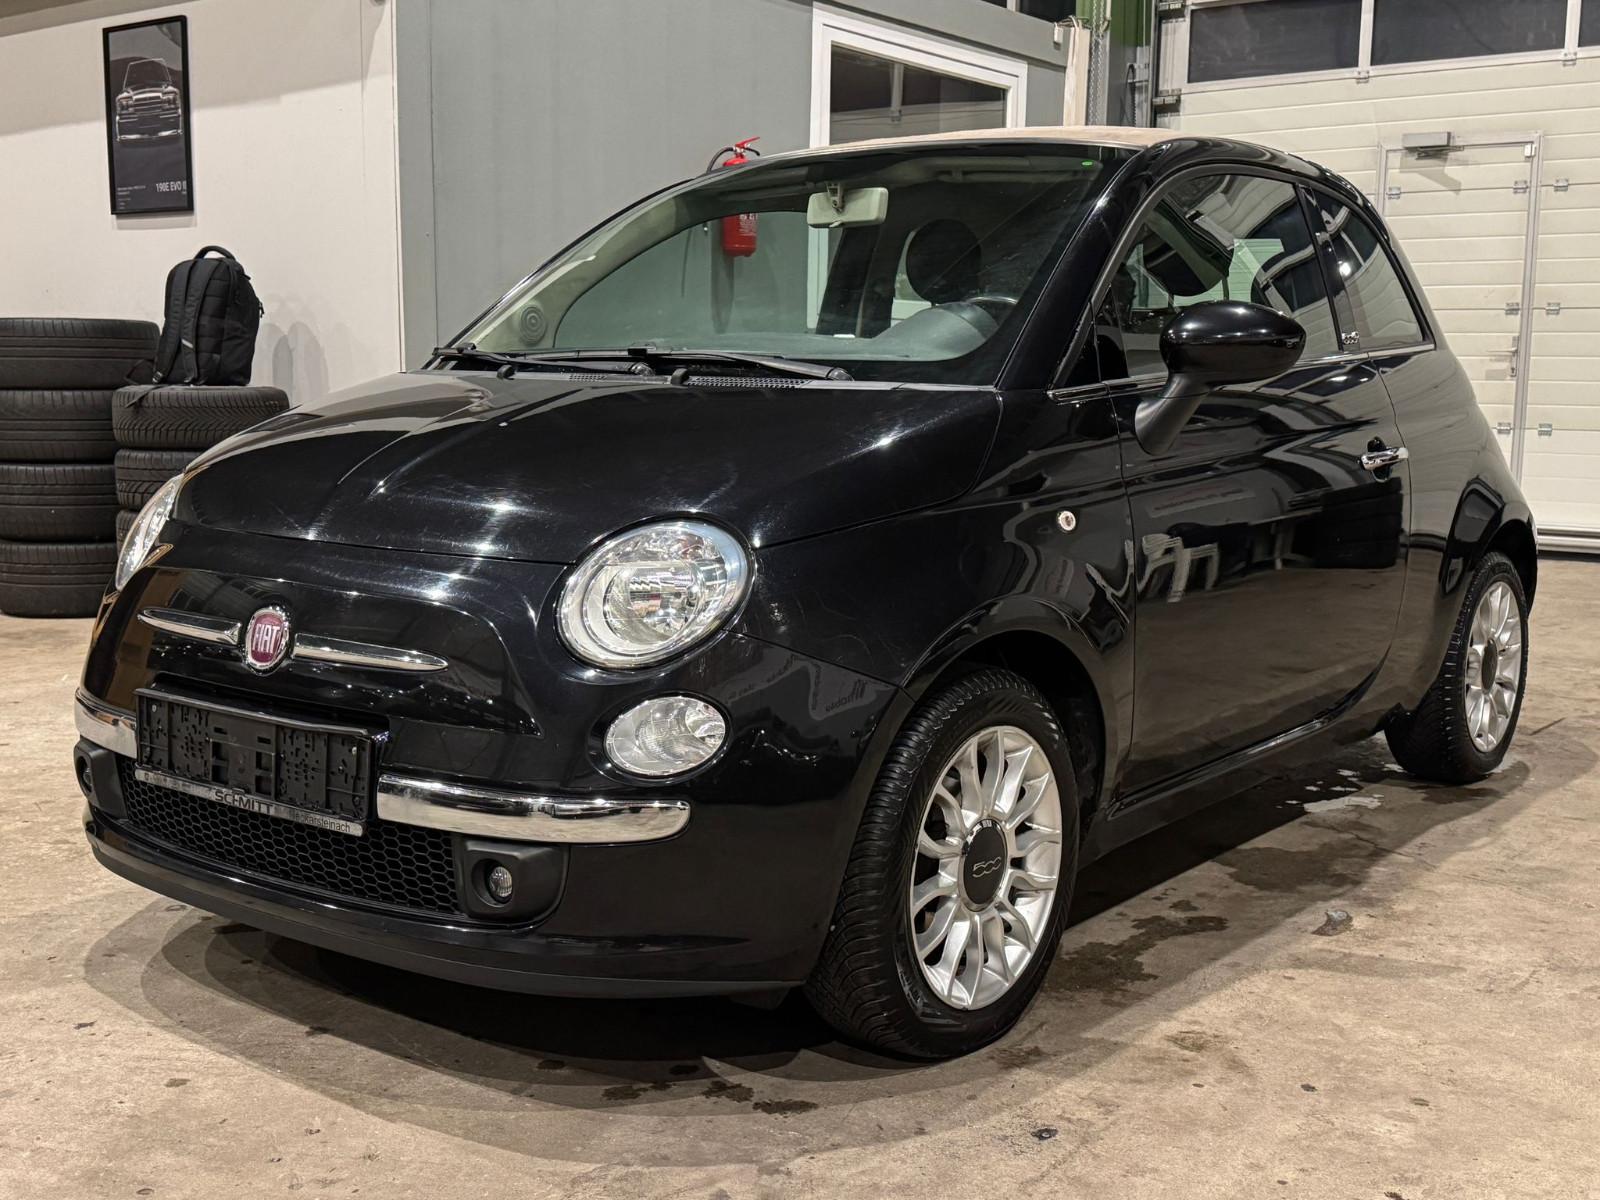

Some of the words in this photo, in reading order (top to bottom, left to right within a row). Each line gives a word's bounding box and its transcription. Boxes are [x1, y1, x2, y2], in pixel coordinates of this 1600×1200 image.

[155, 183, 170, 193] 190E
[170, 181, 182, 192] EVO
[252, 623, 280, 654] FIAT
[972, 856, 1002, 878] 500
